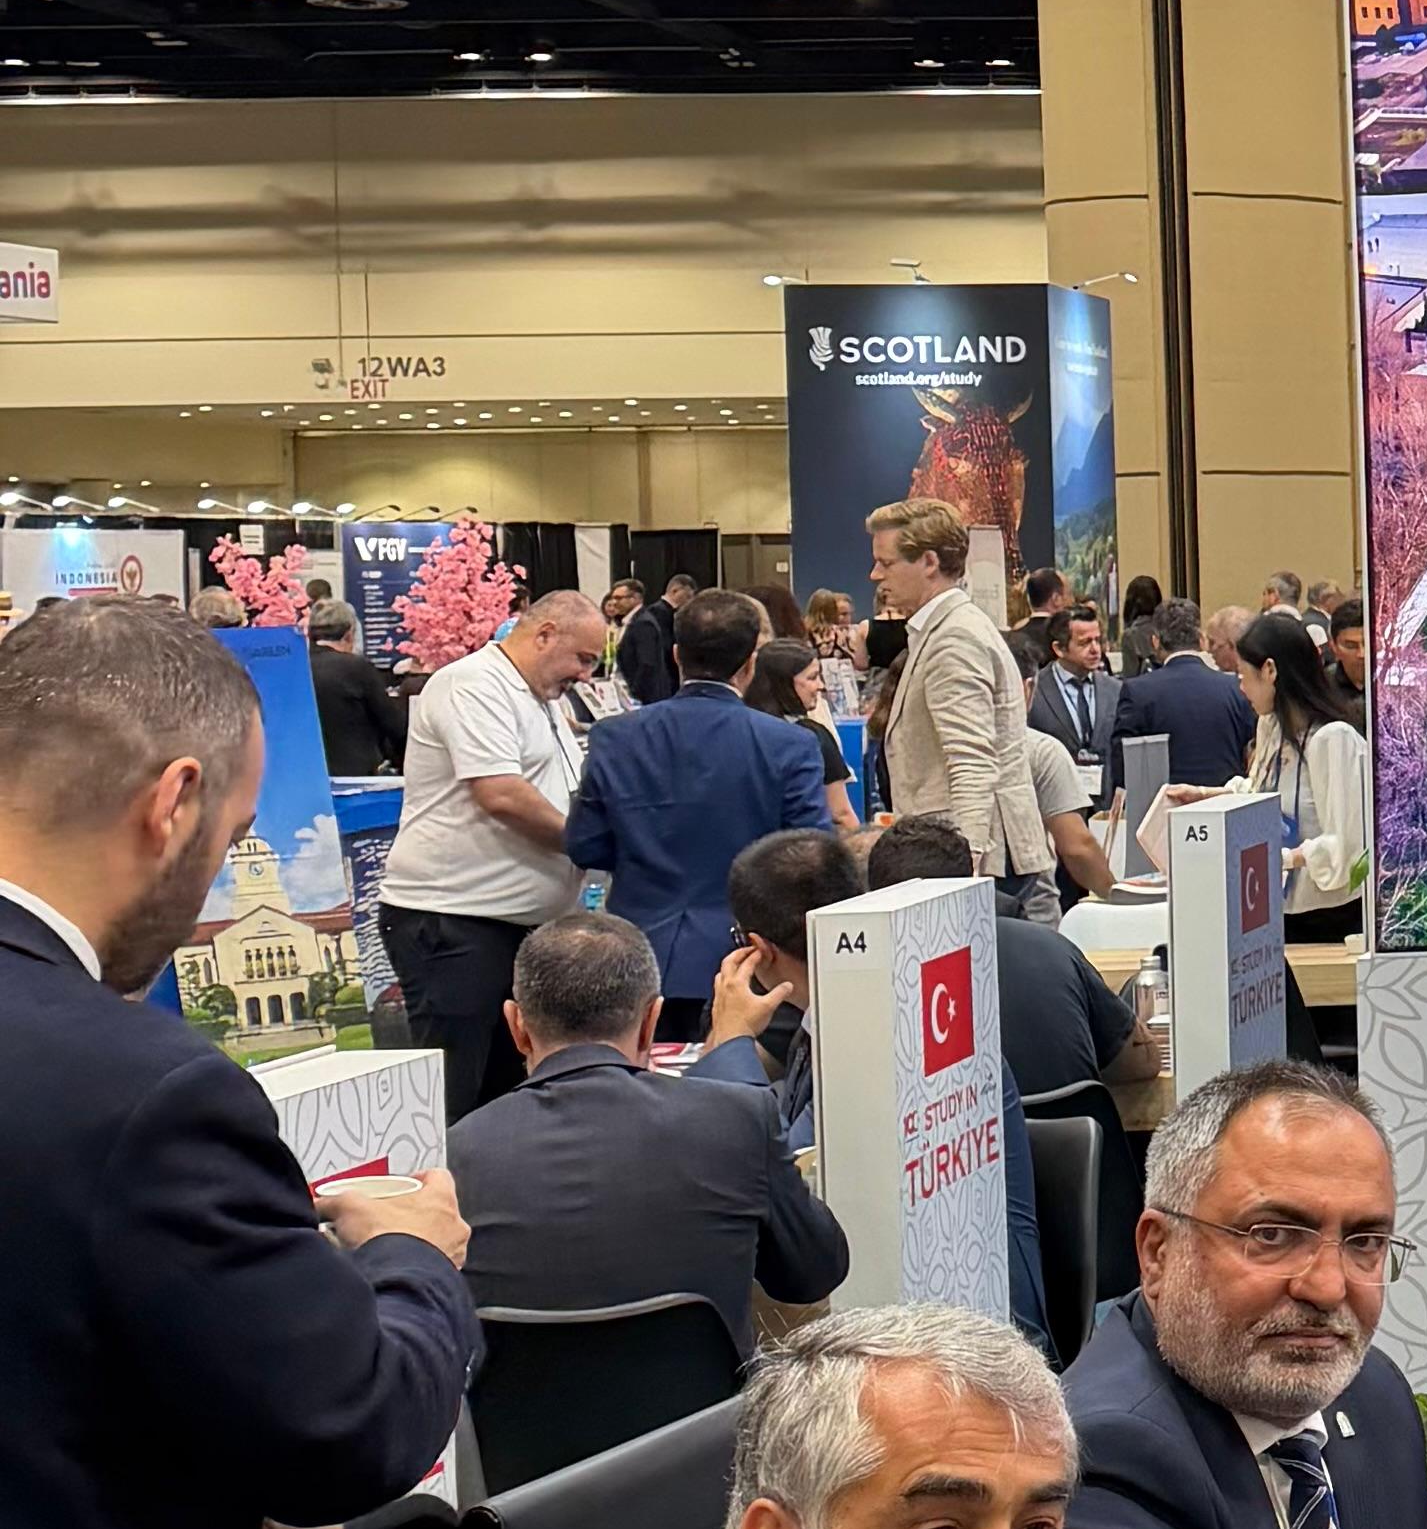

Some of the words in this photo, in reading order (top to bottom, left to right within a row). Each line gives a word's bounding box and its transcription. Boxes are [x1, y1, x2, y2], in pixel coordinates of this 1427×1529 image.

[840, 335, 1027, 364] SCOTLAND
[357, 356, 446, 378] 12WA3
[350, 378, 389, 399] EXIT
[855, 371, 983, 387] scotland.org/study
[55, 570, 118, 585] INDONESIA
[1185, 823, 1209, 844] A5
[835, 930, 867, 955] A4
[1231, 970, 1283, 1029] TÜRKİYE
[924, 1088, 965, 1132] STUDY
[966, 1082, 978, 1111] IN
[905, 1116, 1000, 1208] TÜRKİYE
